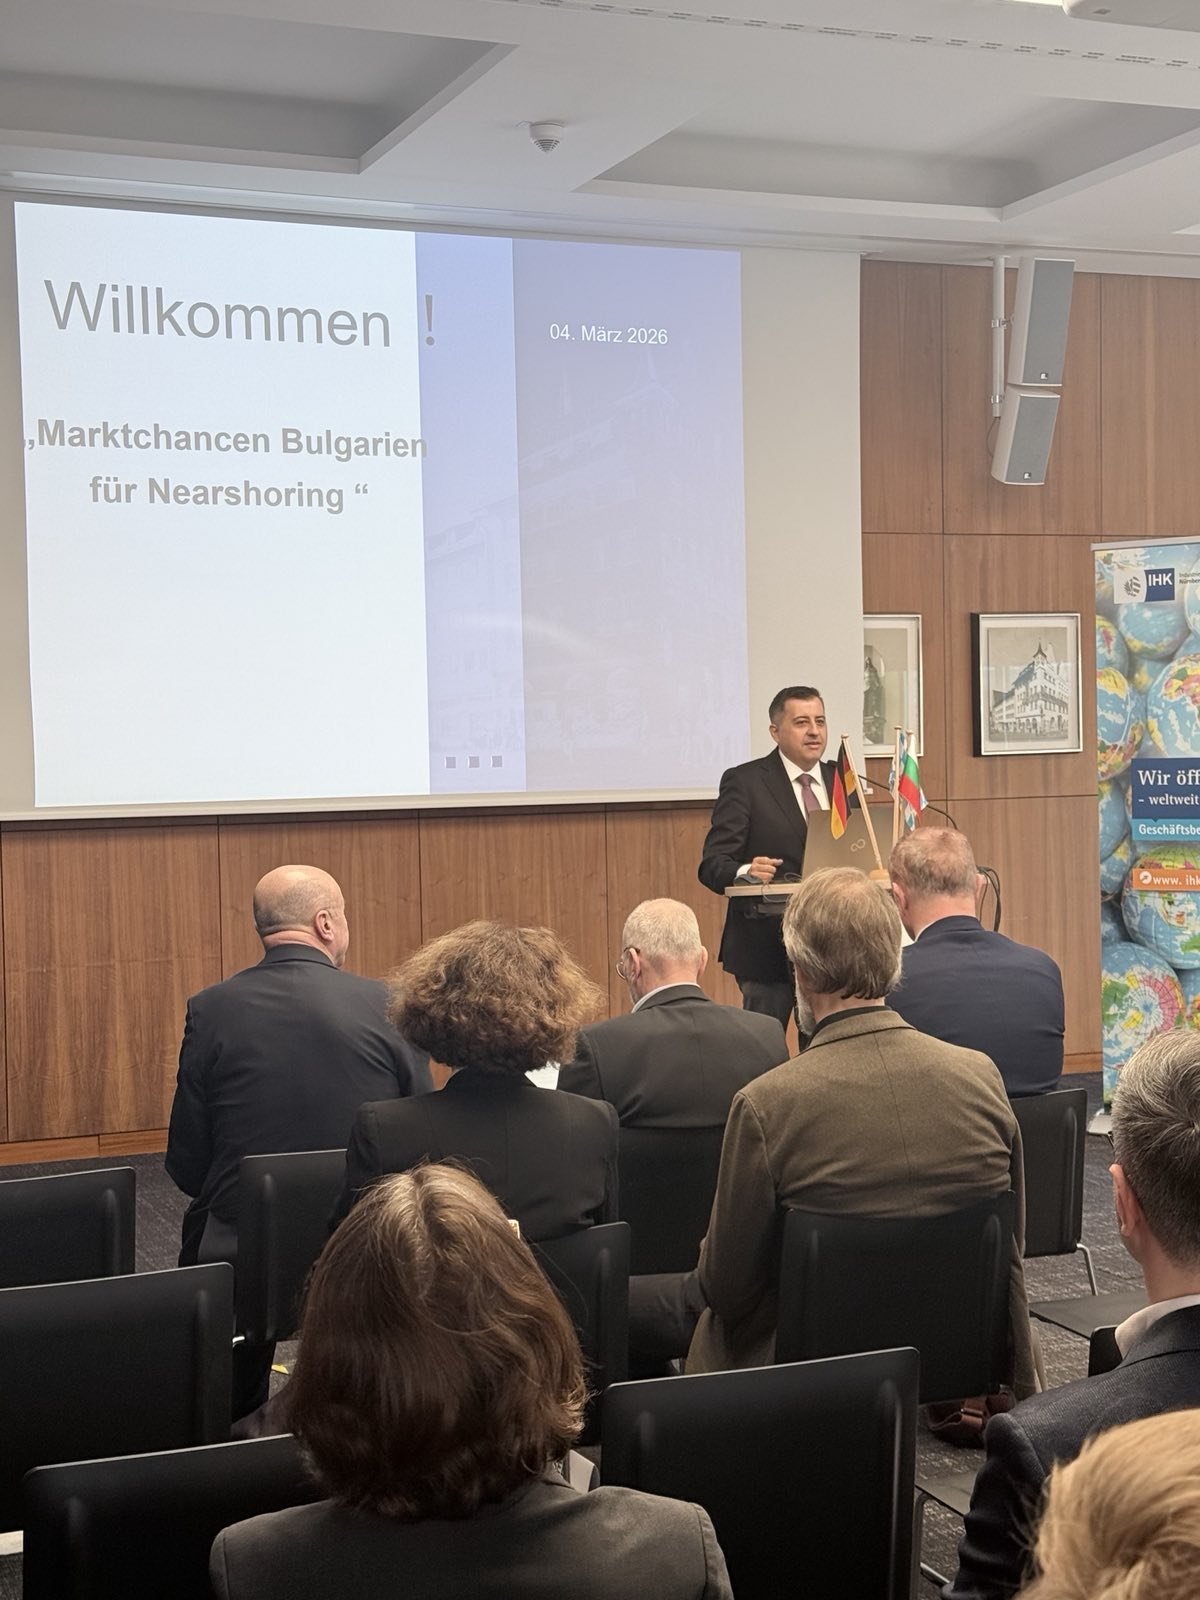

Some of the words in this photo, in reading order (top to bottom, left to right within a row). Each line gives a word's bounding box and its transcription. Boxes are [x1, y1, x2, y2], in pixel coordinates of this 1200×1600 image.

[43, 279, 391, 348] Willkommen
[424, 294, 436, 346] !
[549, 323, 576, 341] 04.
[581, 325, 623, 343] März
[627, 327, 668, 345] 2026
[281, 427, 428, 463] Bulgarien
[89, 475, 138, 504] für
[148, 477, 344, 515] Nearshoring
[1148, 573, 1173, 586] IHK
[1137, 769, 1171, 786] Wir
[1149, 793, 1200, 805] weltweit
